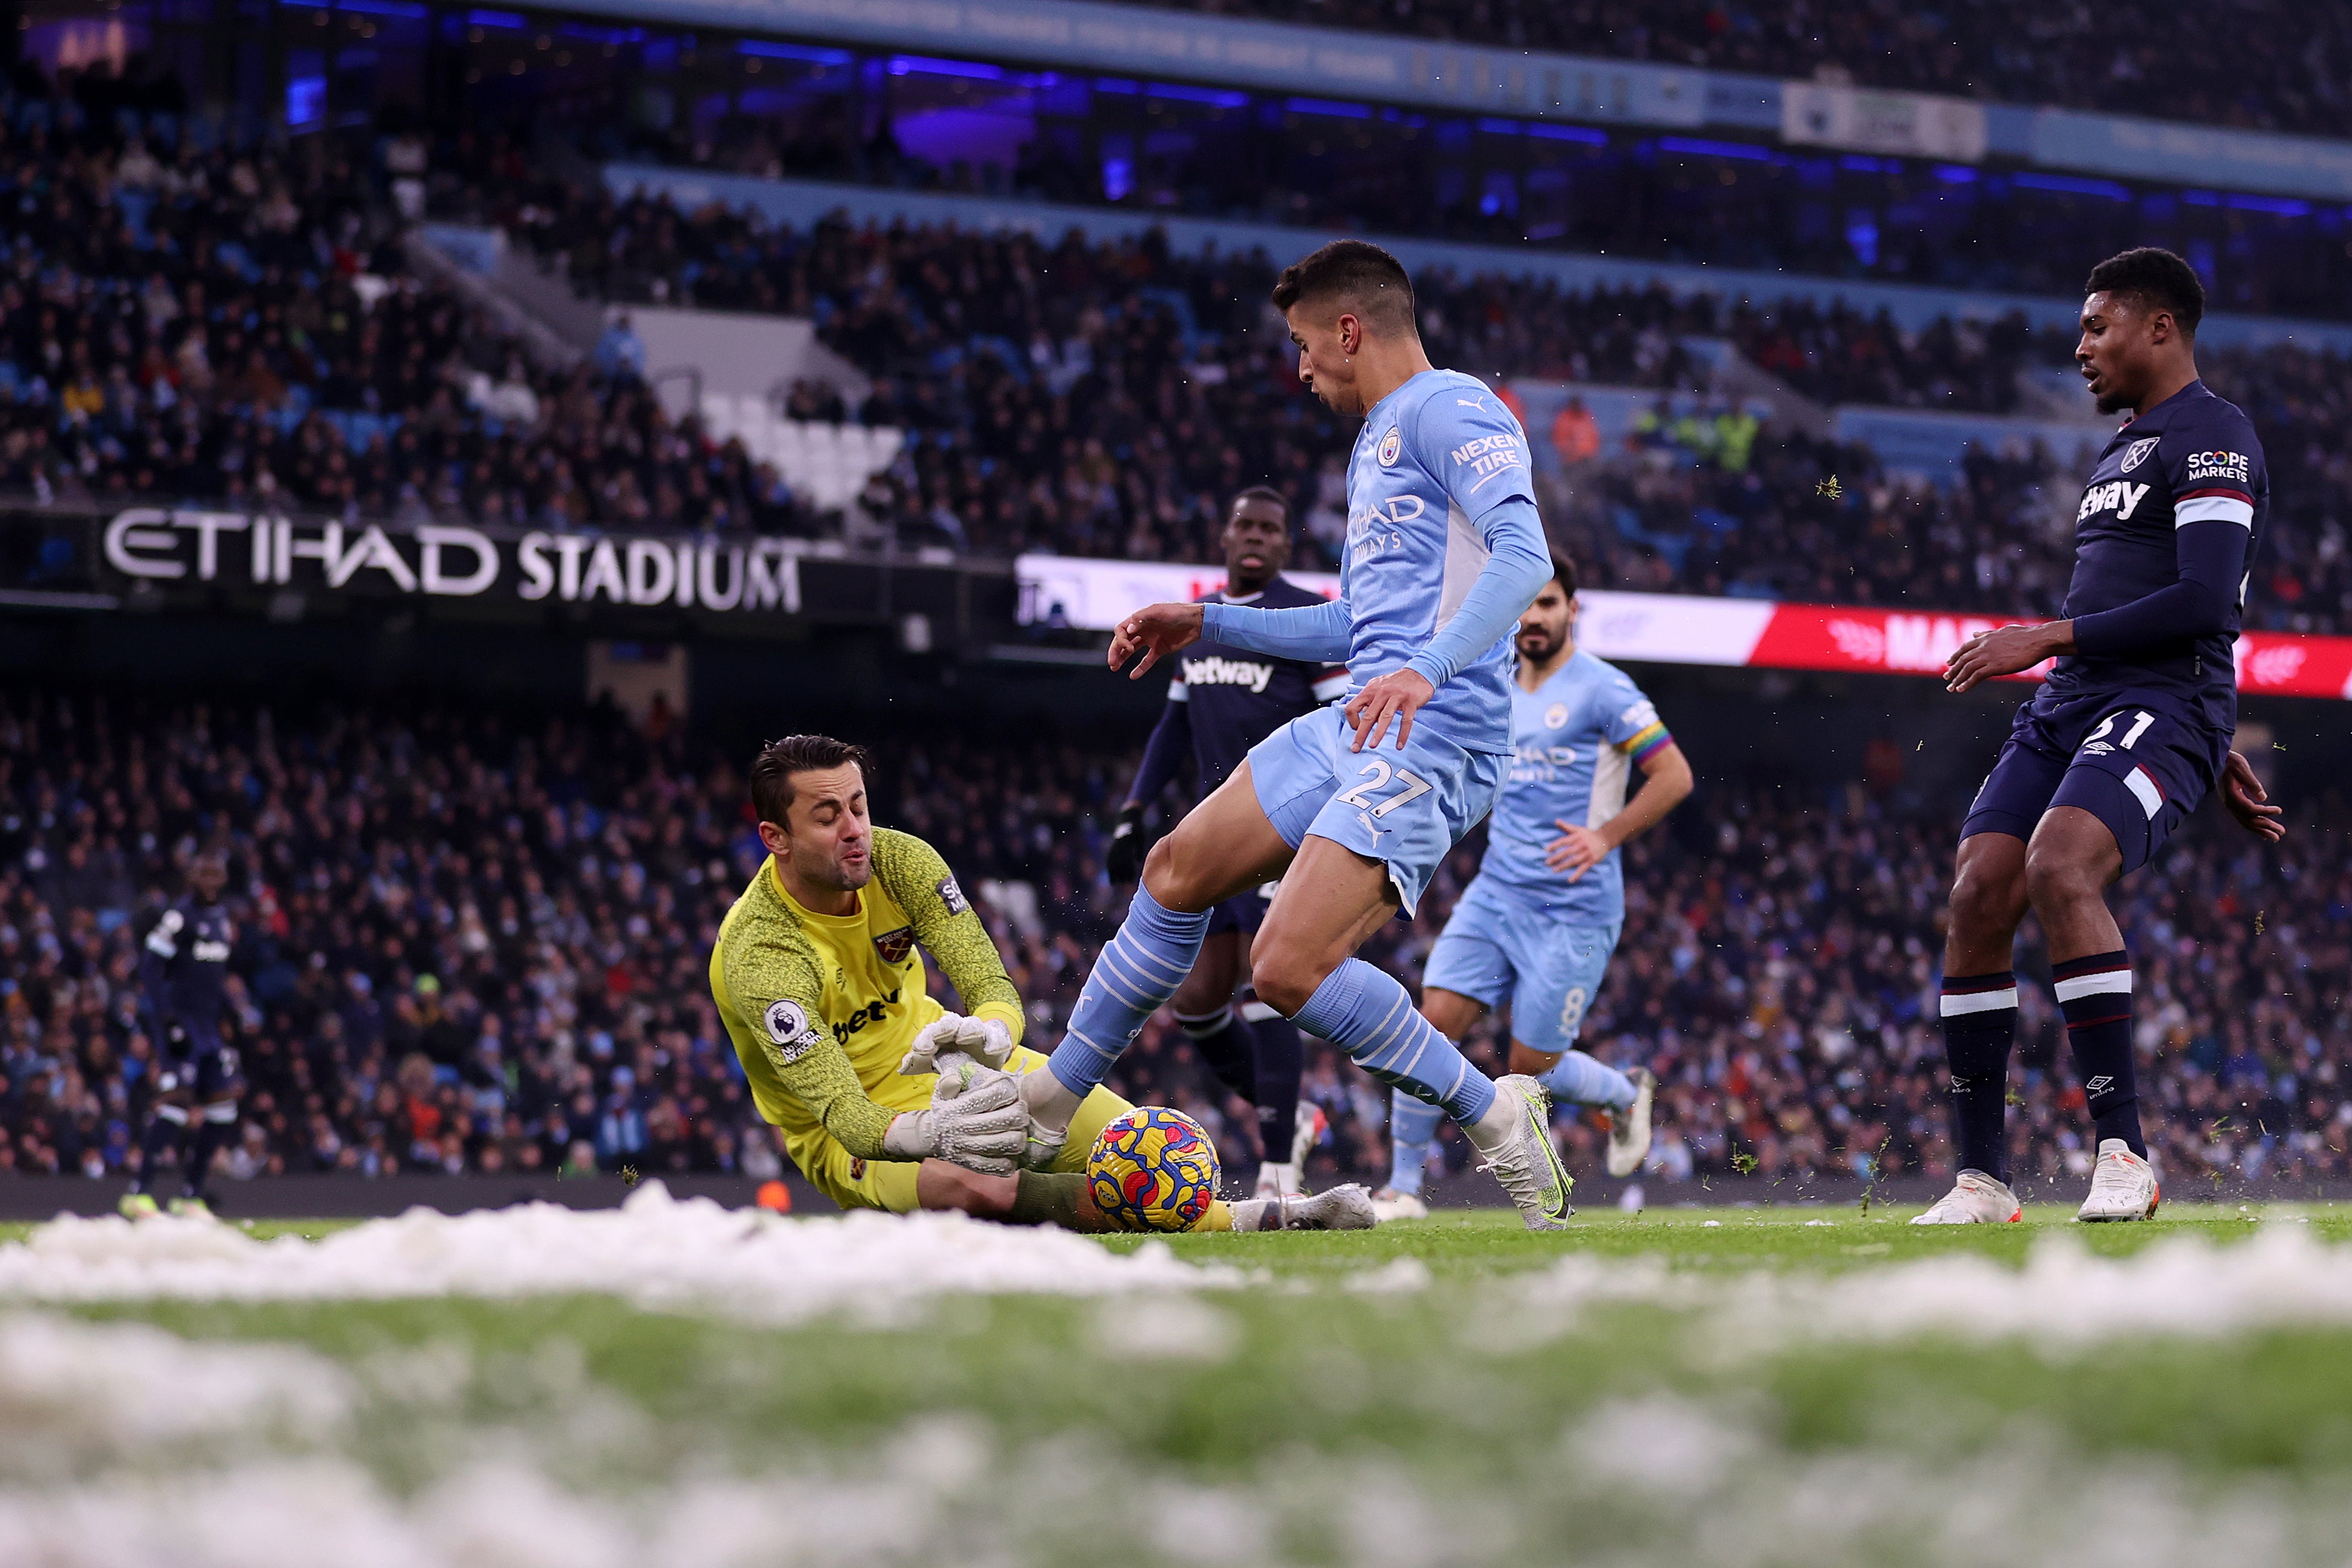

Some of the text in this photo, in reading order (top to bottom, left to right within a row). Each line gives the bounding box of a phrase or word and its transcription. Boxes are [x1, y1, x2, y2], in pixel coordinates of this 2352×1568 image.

[1451, 434, 1521, 466] NEXEN
[1470, 450, 1520, 475] TIRE
[2188, 451, 2248, 472] SCOPE
[2189, 466, 2247, 482] MARKETS
[104, 508, 802, 614] ETIHAD STADIUM
[1336, 759, 1434, 819] 27
[1561, 986, 1586, 1026] 8
[781, 1031, 815, 1058] No room
[796, 1034, 824, 1056] racism
[2089, 1086, 2115, 1100] umbro
